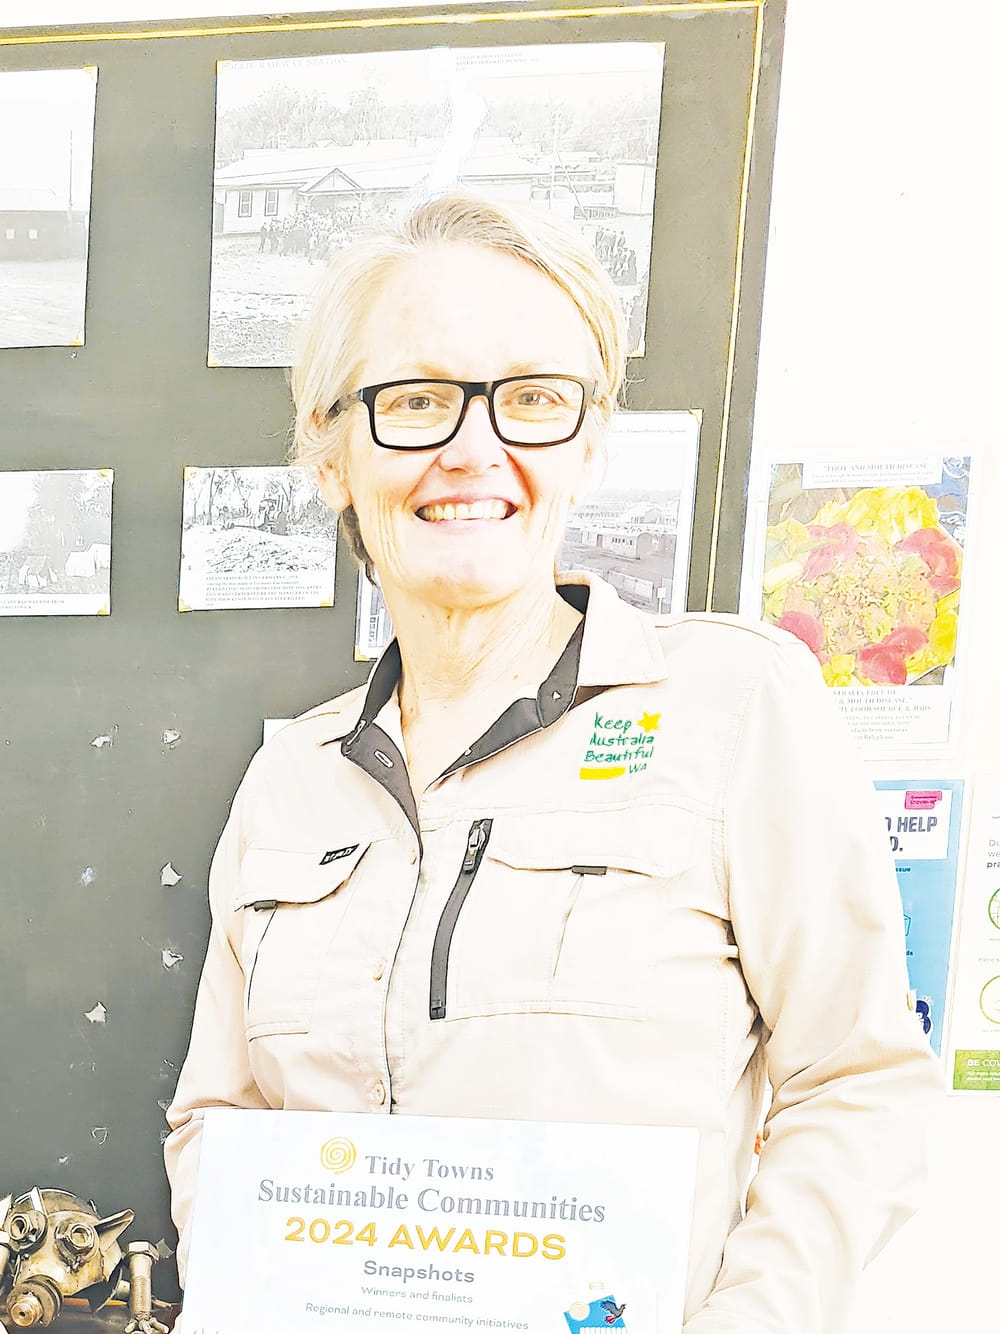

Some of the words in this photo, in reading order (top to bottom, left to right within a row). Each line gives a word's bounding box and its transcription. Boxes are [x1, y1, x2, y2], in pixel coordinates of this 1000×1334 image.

[594, 712, 632, 734] Keep
[589, 732, 655, 747] Australia
[584, 746, 655, 763] Beautiful
[629, 763, 647, 775] WA
[897, 816, 938, 832] HELP
[365, 1155, 415, 1180] Tidy
[423, 1159, 495, 1182] Towns
[257, 1179, 409, 1211] Sustainable
[417, 1187, 606, 1224] Communities
[284, 1216, 379, 1248] 2024
[388, 1225, 567, 1261] AWARDS
[363, 1260, 476, 1285] Snapshots
[361, 1286, 407, 1301] Winners
[409, 1290, 430, 1301] and
[431, 1291, 474, 1304] finalists
[305, 1303, 349, 1318] Regional
[352, 1306, 371, 1319] and
[374, 1310, 414, 1322] remote
[416, 1313, 473, 1329] community
[475, 1316, 529, 1331] initiatives
